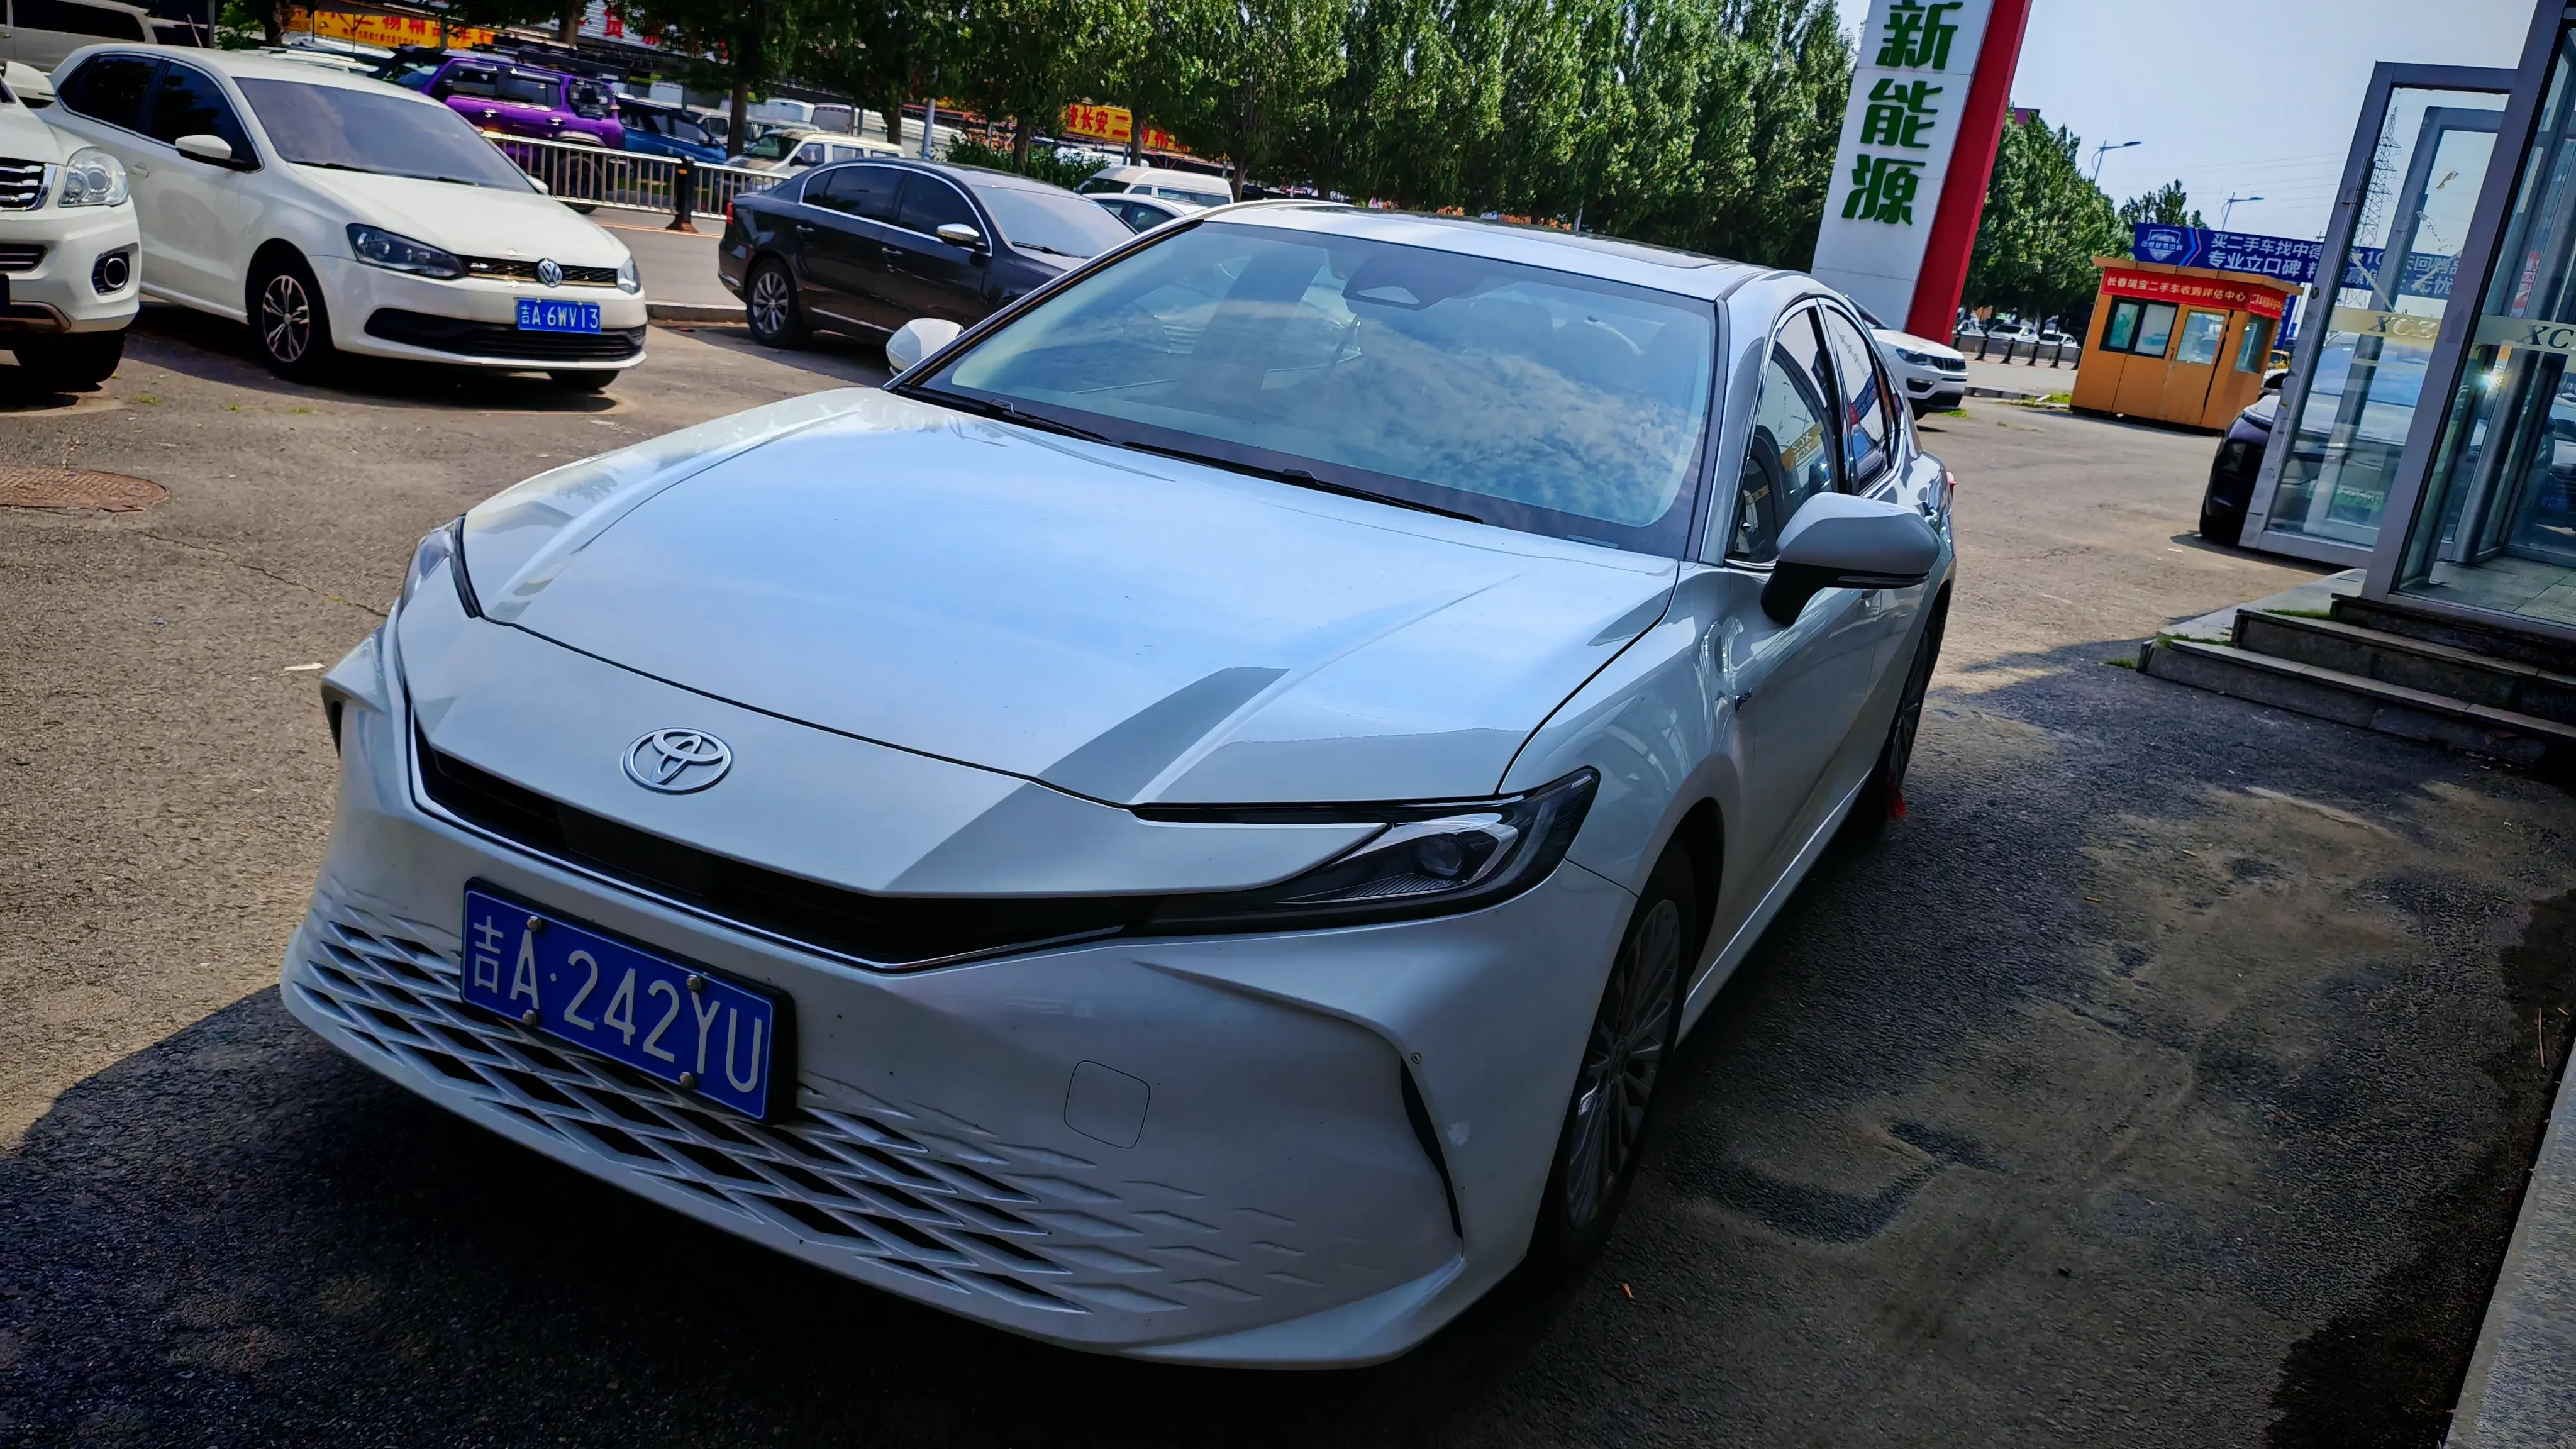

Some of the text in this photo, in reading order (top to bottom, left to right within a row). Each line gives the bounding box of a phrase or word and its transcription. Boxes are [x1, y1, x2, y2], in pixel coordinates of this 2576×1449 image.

[1841, 0, 1963, 226] 新能源
[2208, 250, 2302, 277] 专业立口碑
[2516, 324, 2576, 350] XC
